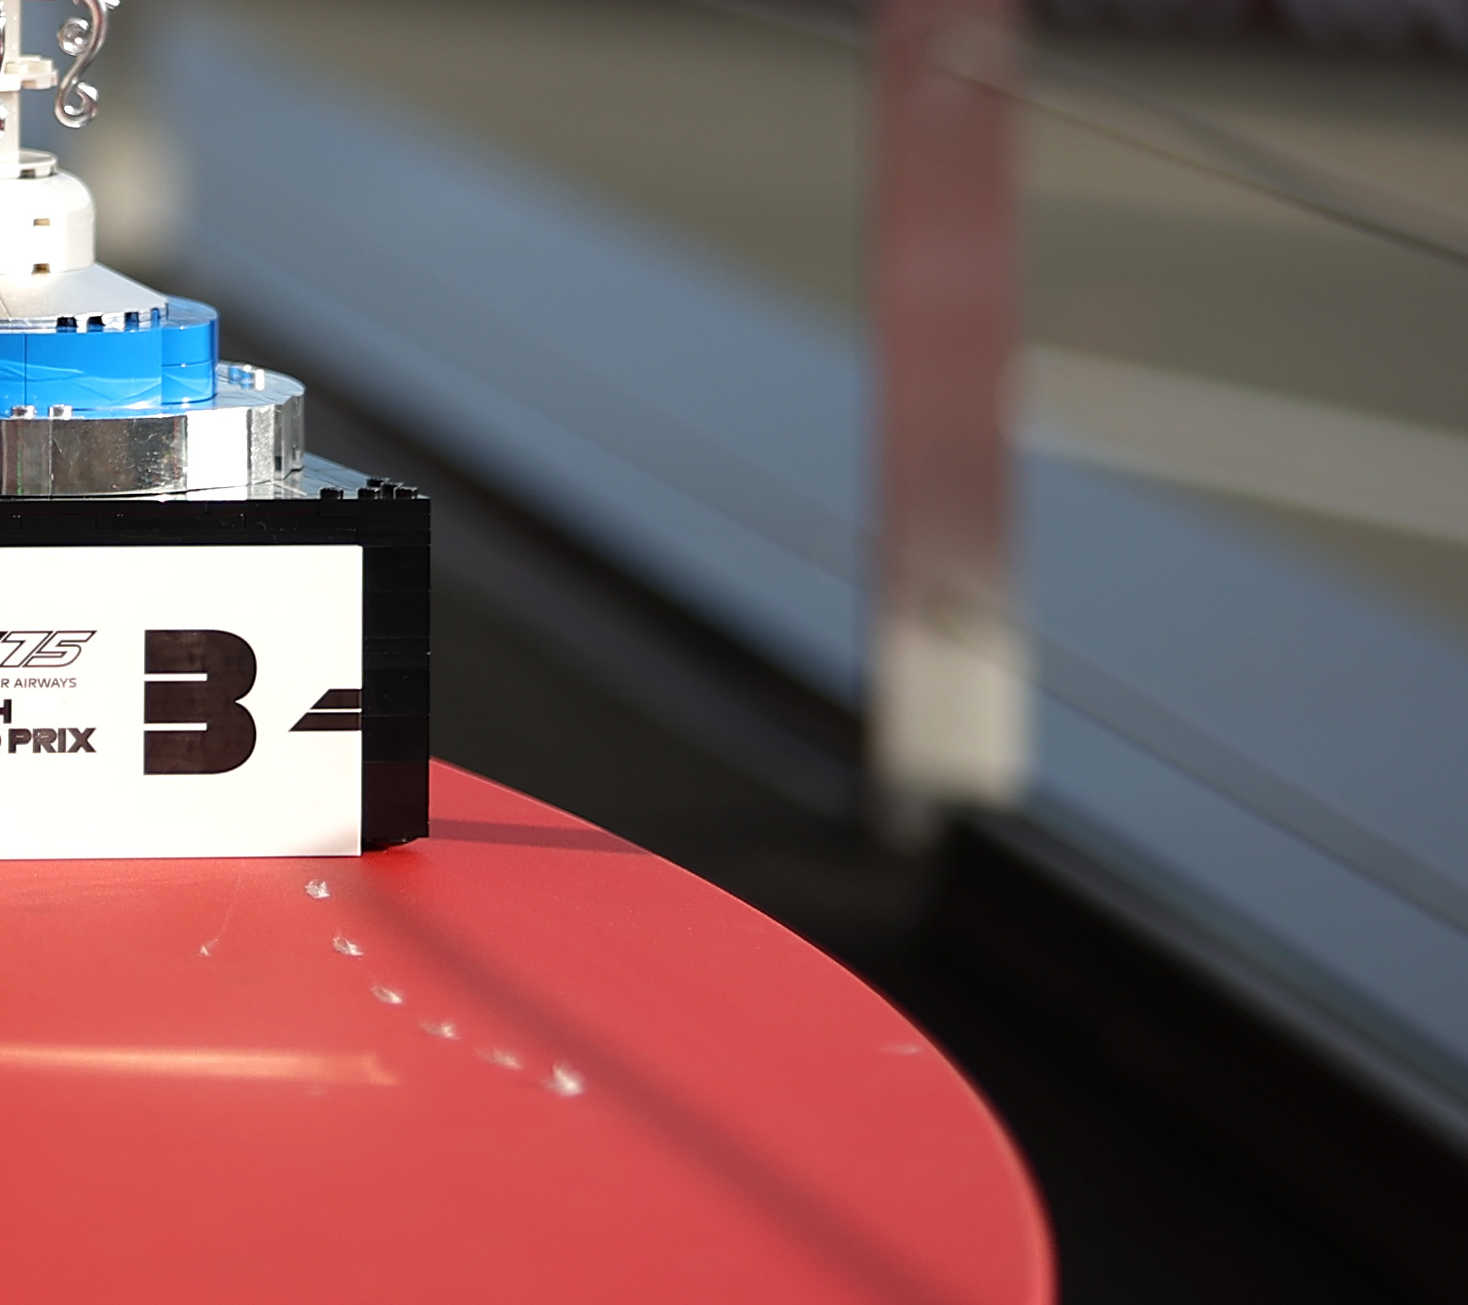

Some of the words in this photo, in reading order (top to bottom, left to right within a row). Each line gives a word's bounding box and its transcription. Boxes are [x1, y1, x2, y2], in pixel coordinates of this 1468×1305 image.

[14, 678, 77, 688] AIRWAYS
[143, 629, 257, 775] 3
[8, 728, 97, 753] PRIX
